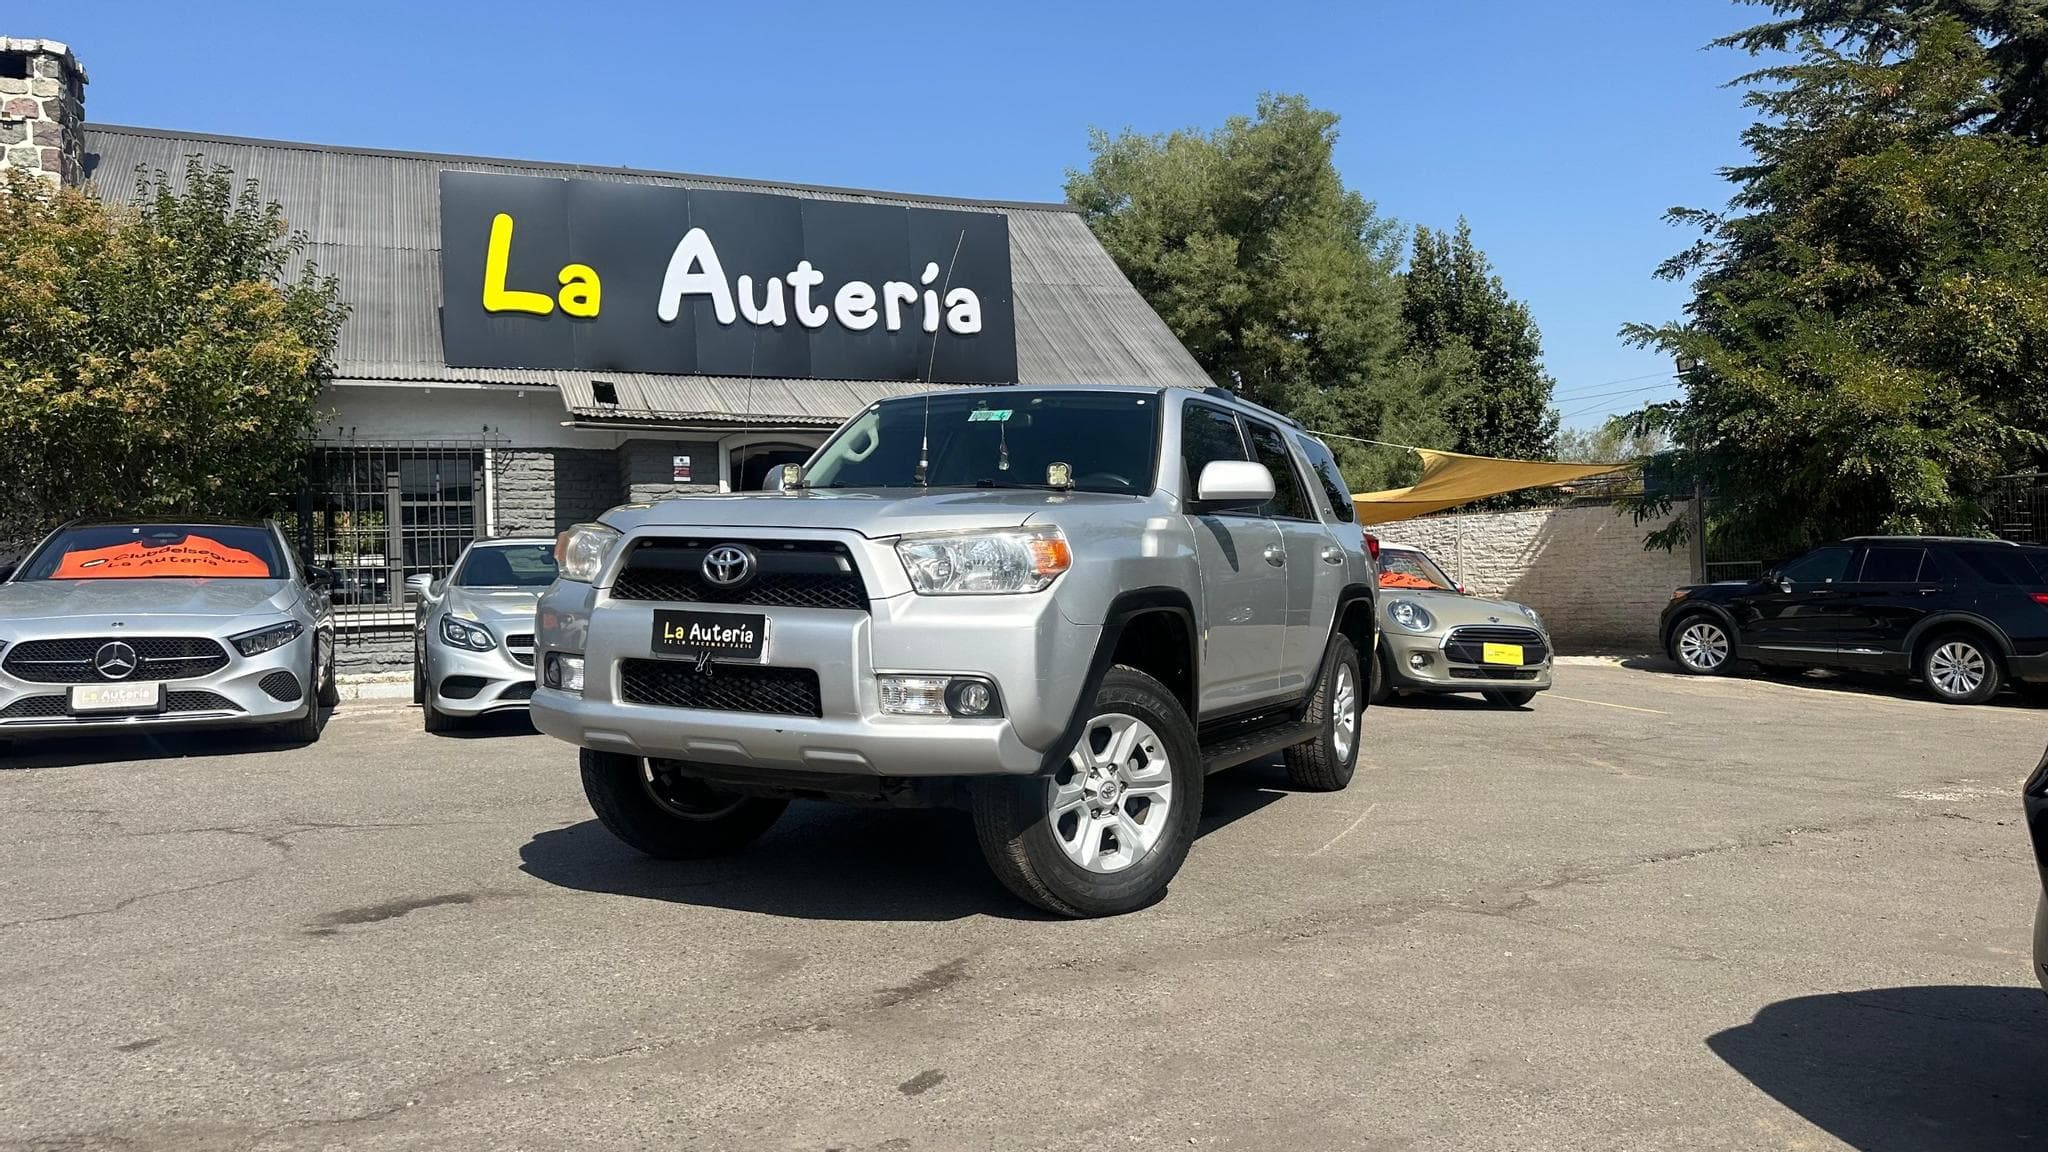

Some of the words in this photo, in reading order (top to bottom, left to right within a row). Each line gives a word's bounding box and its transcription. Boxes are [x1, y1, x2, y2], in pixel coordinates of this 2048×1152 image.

[482, 212, 602, 319] La
[656, 226, 983, 335] Autería
[107, 560, 131, 569] La
[140, 556, 218, 567] Autería
[113, 546, 250, 565] Clubdelseguro
[664, 621, 684, 639] La
[689, 622, 753, 643] Autería
